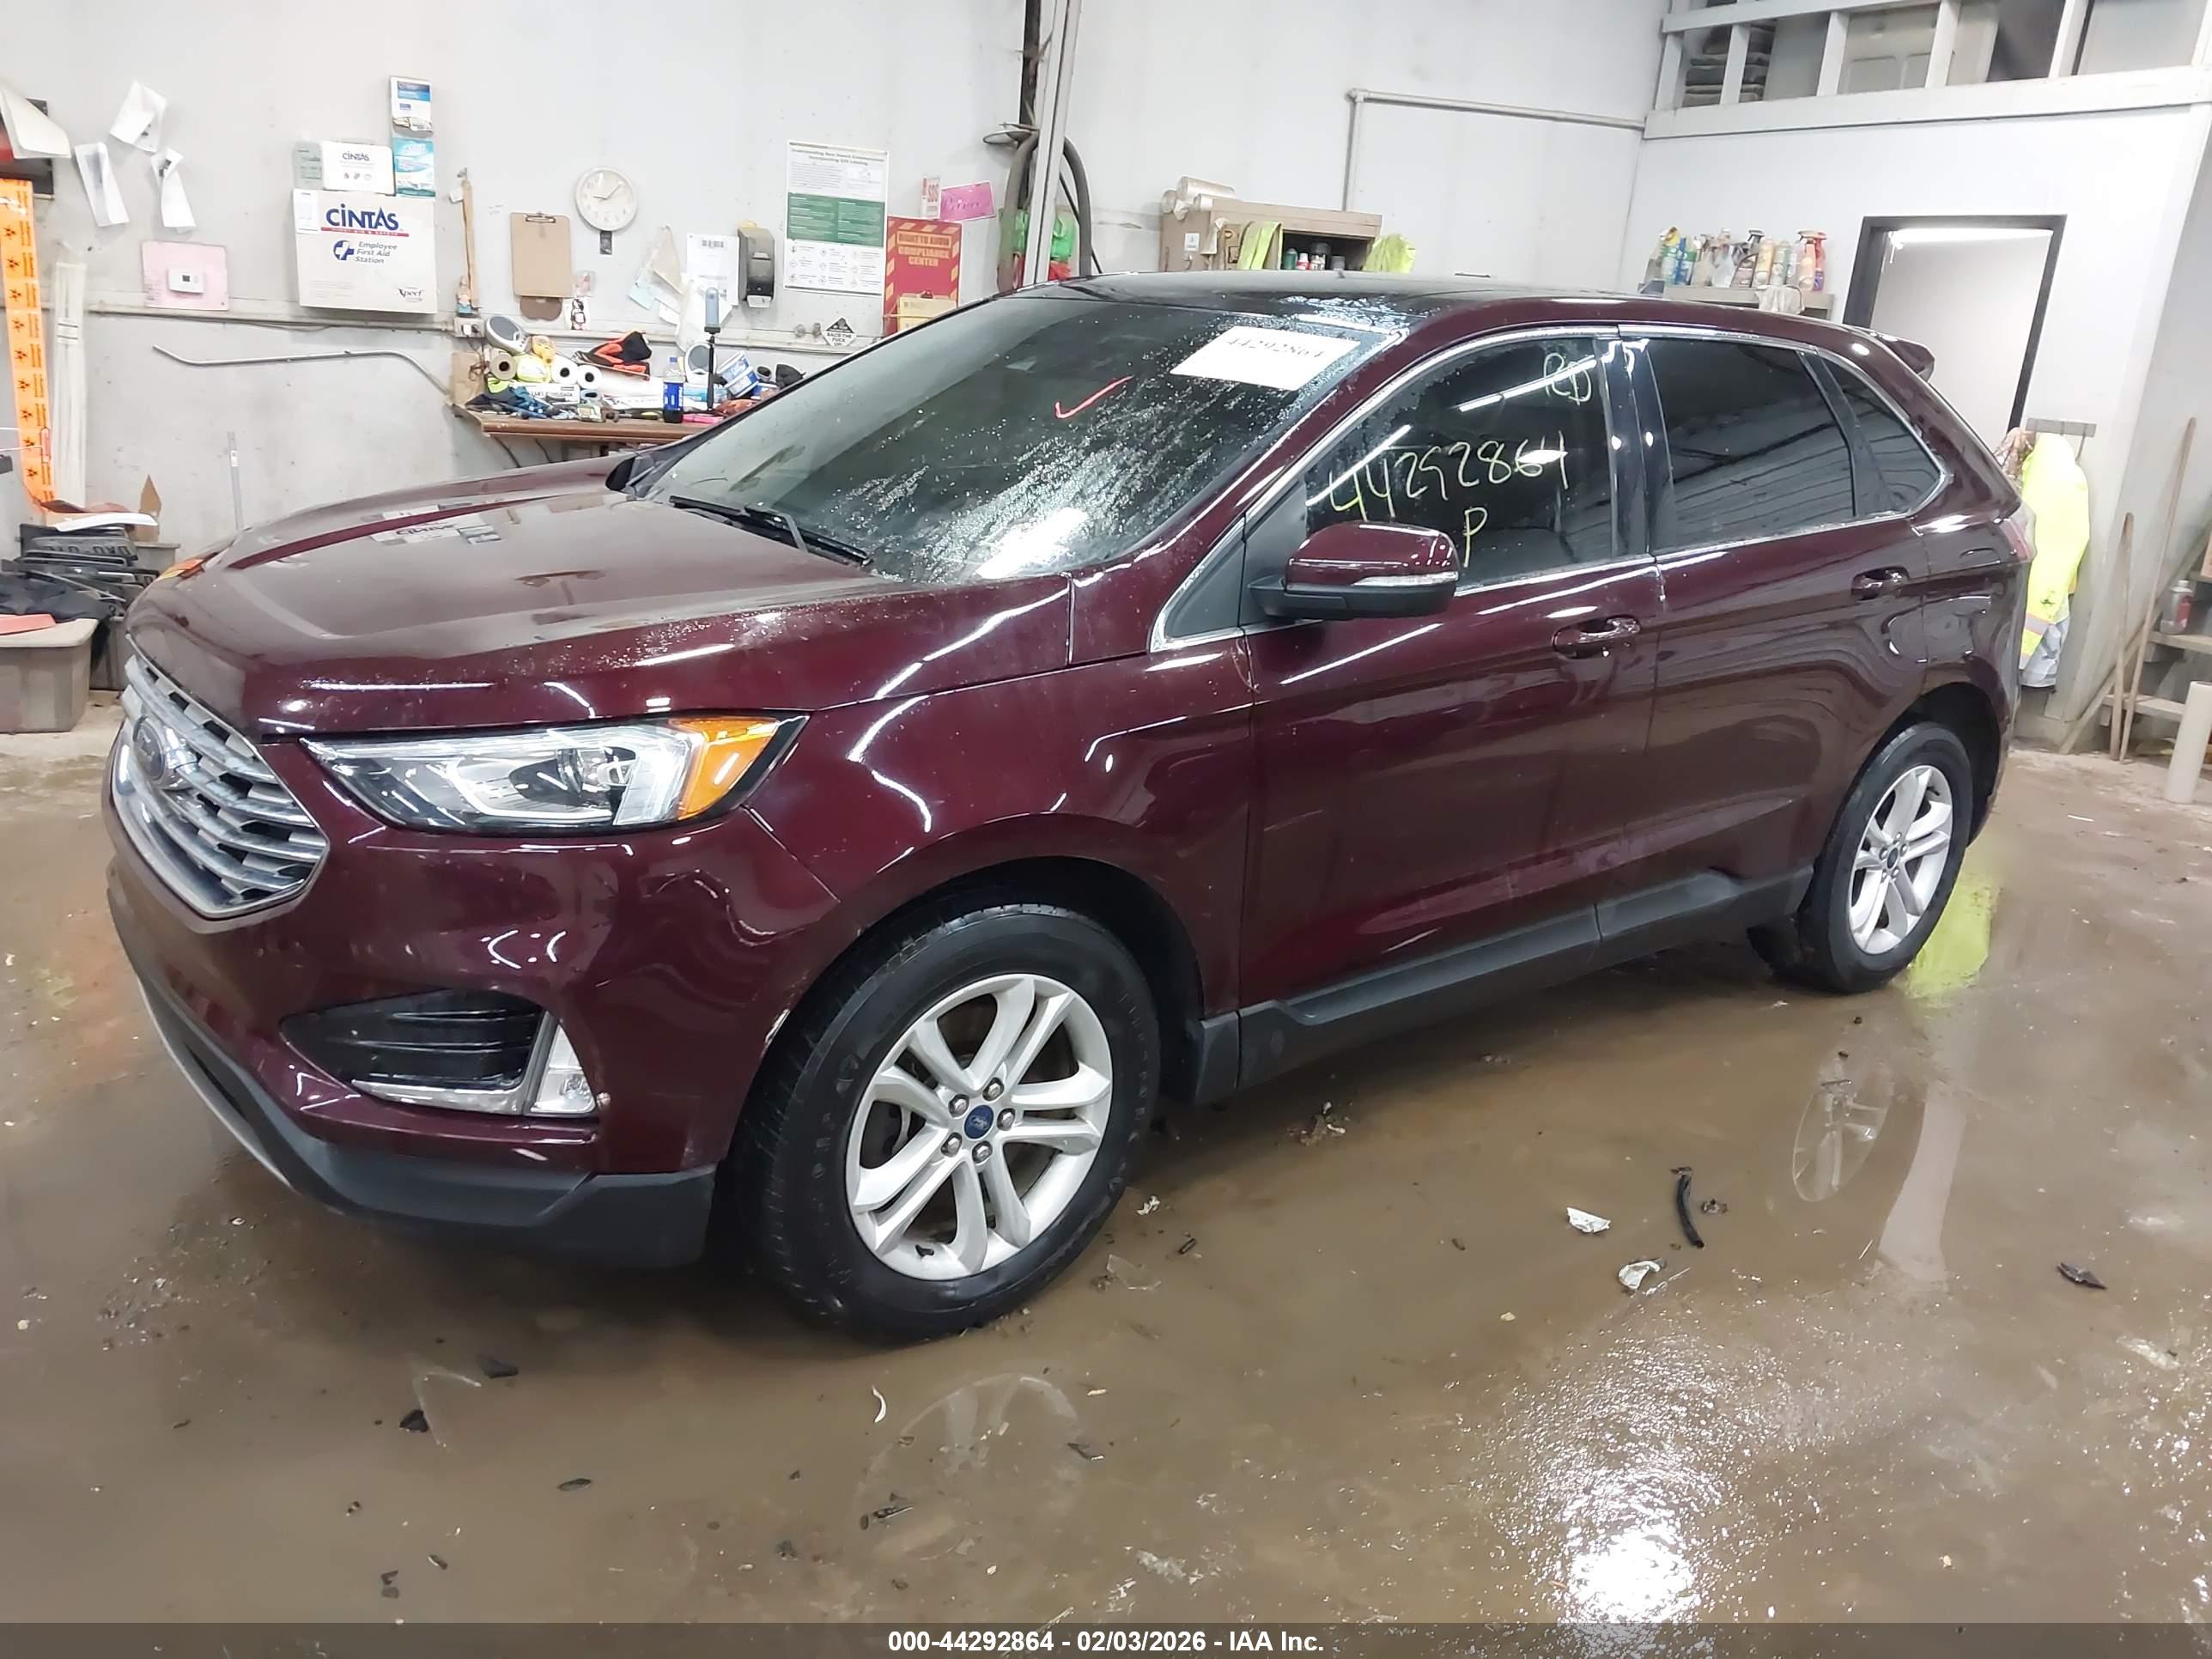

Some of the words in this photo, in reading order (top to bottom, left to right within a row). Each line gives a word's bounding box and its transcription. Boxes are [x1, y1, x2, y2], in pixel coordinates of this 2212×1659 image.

[358, 241, 398, 250] Employee
[355, 256, 385, 264] Station
[908, 257, 939, 266] CENTER
[1328, 430, 1570, 522] 44292864
[1462, 506, 1488, 568] P
